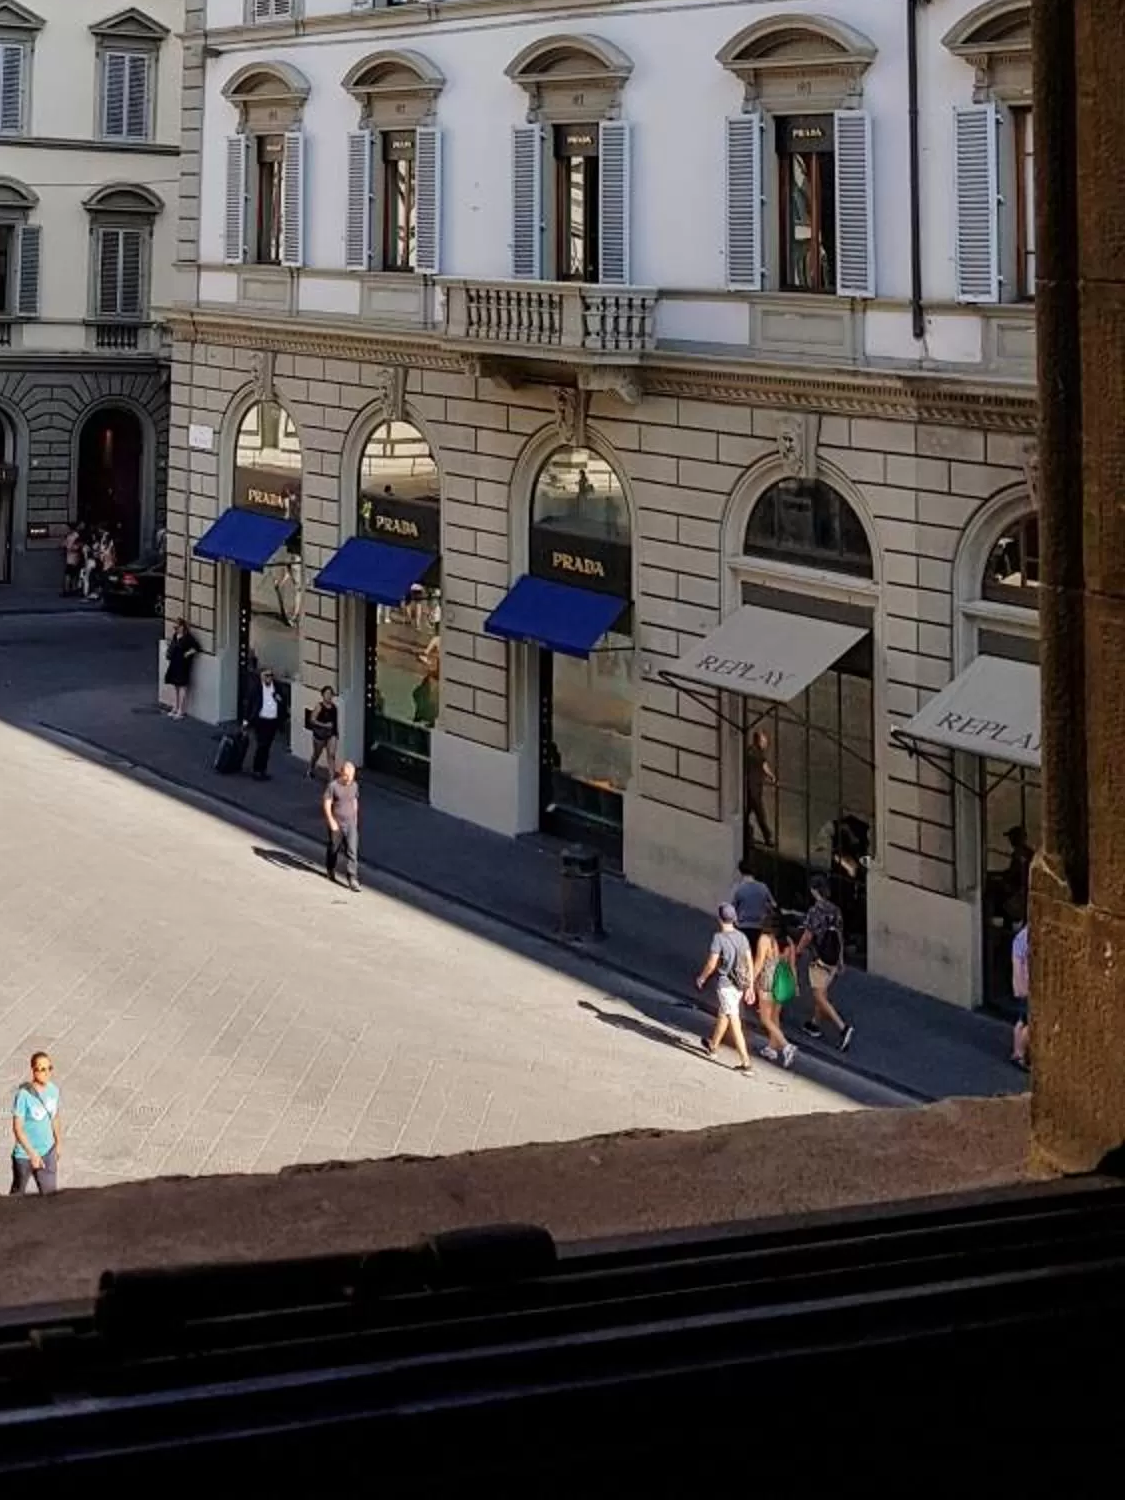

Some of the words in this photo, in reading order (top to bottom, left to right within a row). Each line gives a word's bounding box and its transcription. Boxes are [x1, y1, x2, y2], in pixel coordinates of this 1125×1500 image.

[375, 515, 419, 537] PRADA
[552, 551, 605, 577] PRADA
[696, 654, 796, 687] REPLAY
